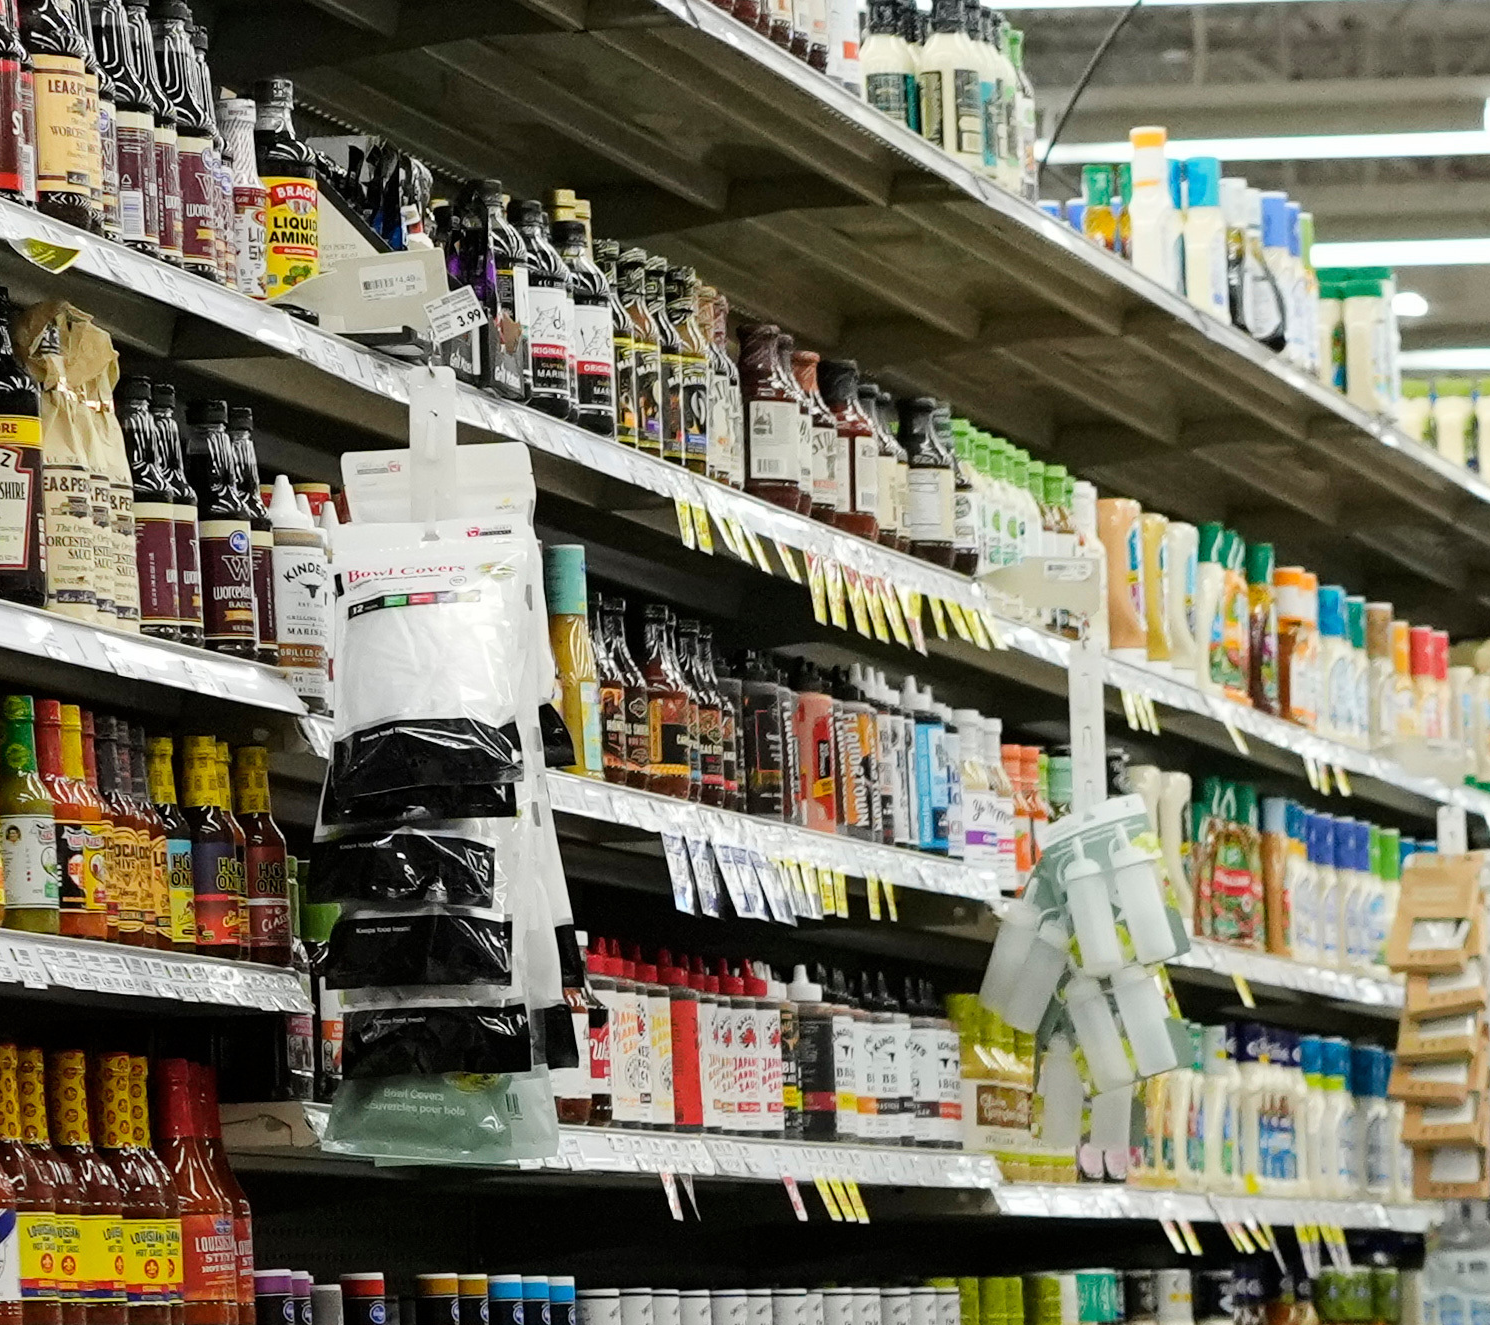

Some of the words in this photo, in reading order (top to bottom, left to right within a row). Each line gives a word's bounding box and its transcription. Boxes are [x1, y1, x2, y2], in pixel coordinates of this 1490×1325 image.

[456, 308, 482, 327] 3.99
[349, 566, 394, 583] Bowl
[401, 563, 466, 576] Covers
[352, 604, 365, 615] 12
[383, 1087, 408, 1099] Bowl
[410, 1089, 445, 1102] Covers
[419, 1104, 443, 1116] pour
